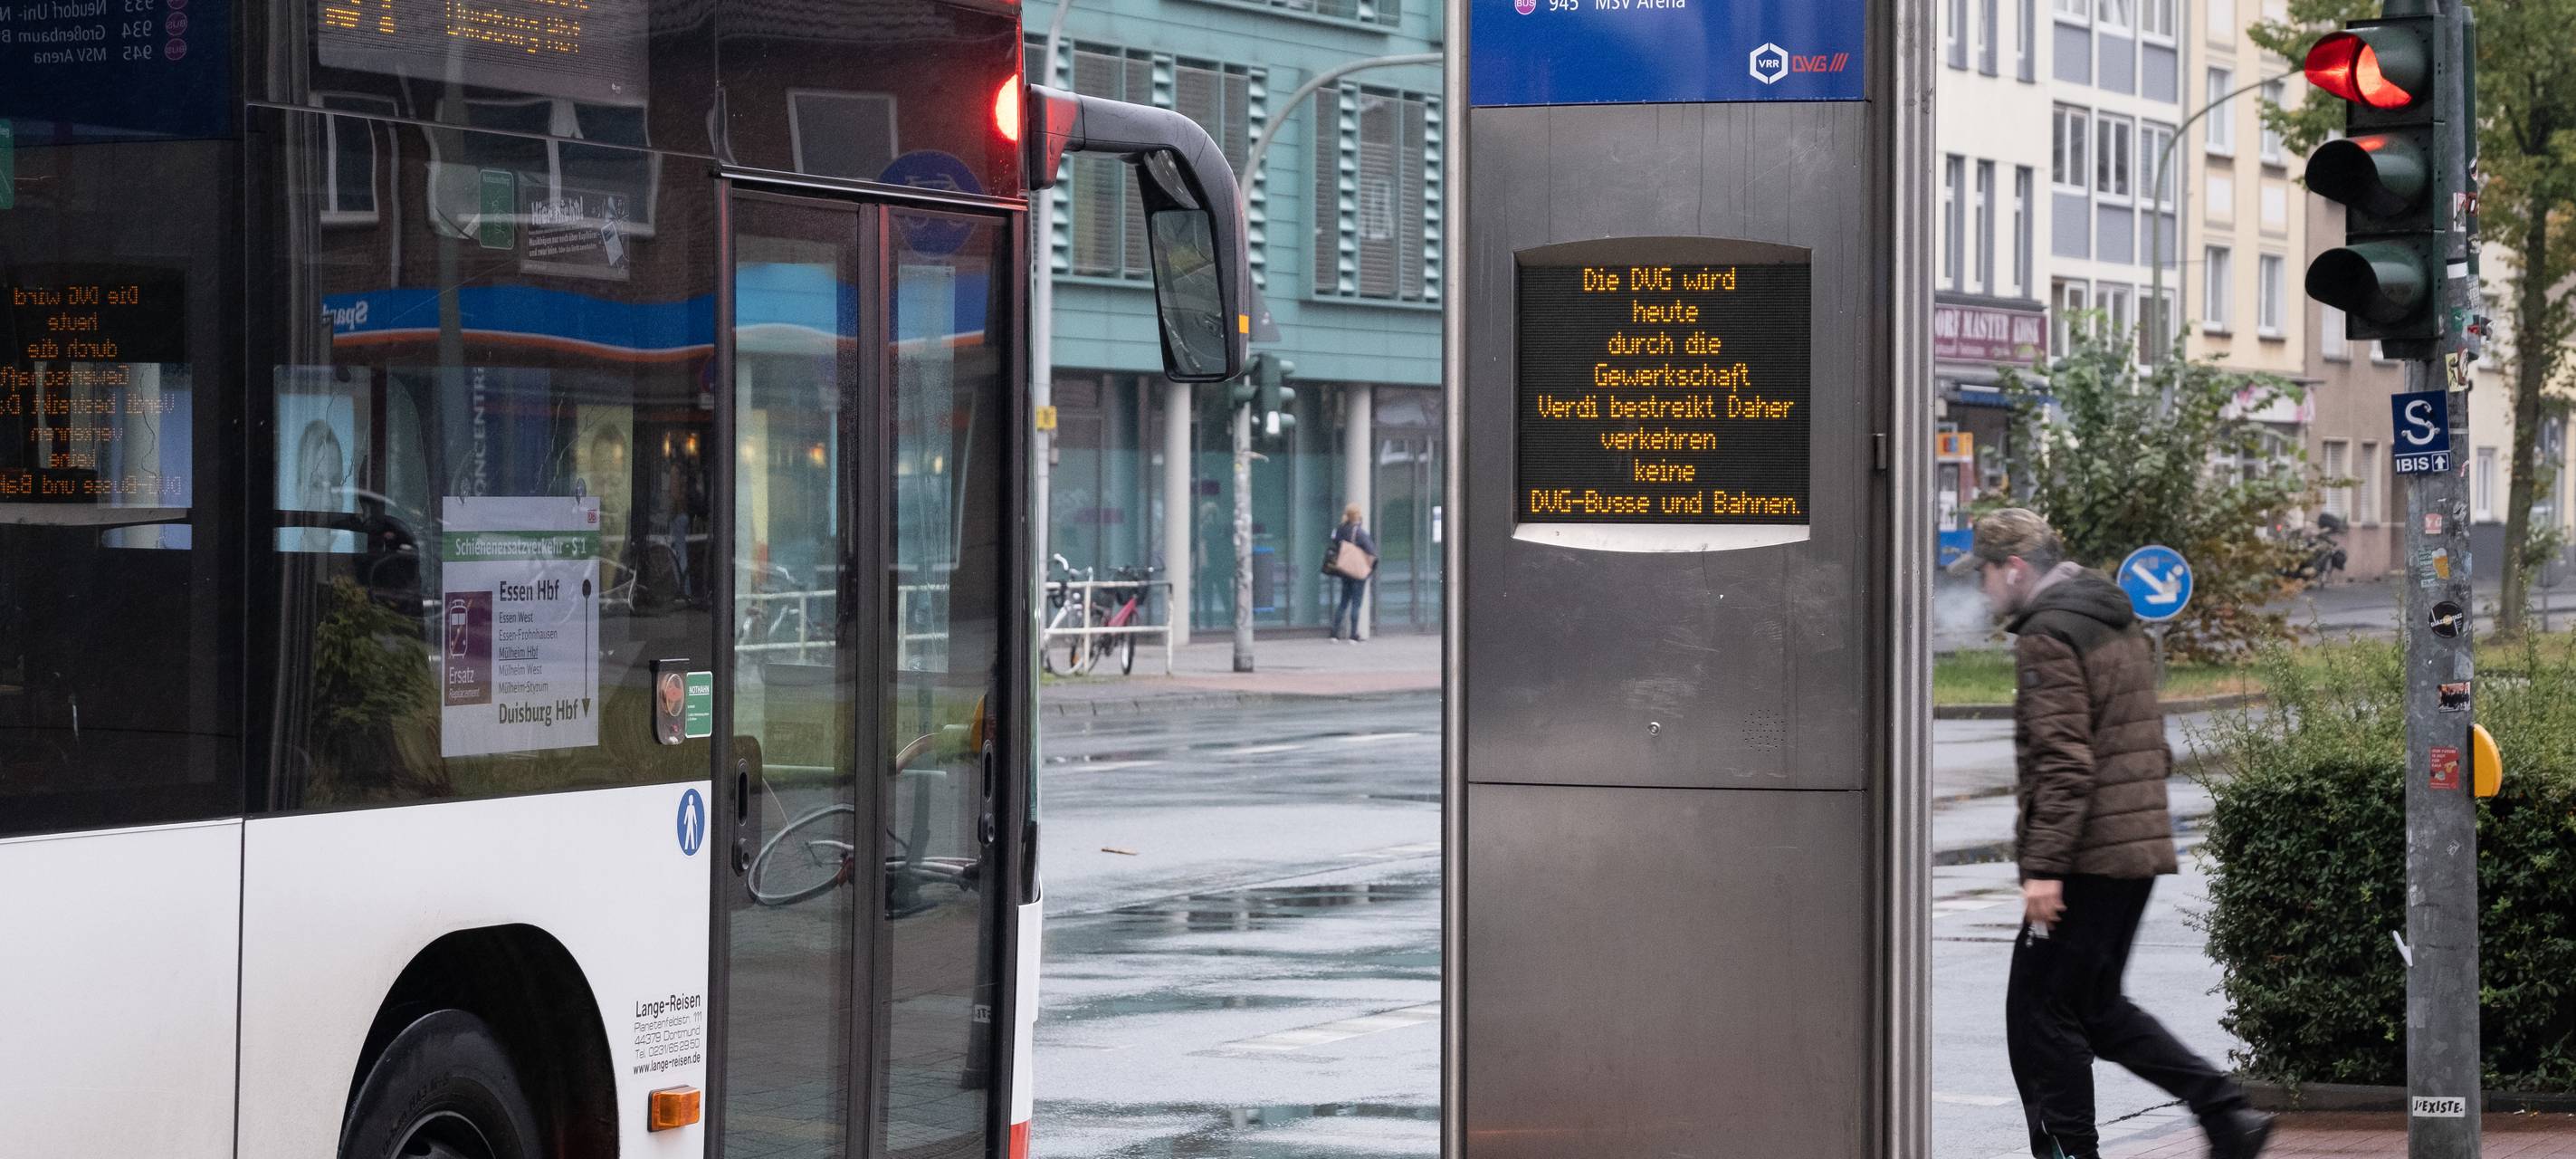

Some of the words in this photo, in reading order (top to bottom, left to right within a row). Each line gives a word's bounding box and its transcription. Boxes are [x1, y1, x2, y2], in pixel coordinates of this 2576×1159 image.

[1550, 0, 1579, 11] 945
[1596, 0, 1630, 10] MSV
[1636, 0, 1685, 8] Arena
[1758, 59, 1779, 69] VRR
[1792, 55, 1827, 72] DVG
[1584, 267, 1619, 291] Die
[1631, 267, 1672, 291] DVG
[1683, 267, 1736, 291] wird
[1633, 300, 1699, 322] heute
[1962, 311, 2008, 341] MASTER
[1608, 331, 1674, 355] durch
[1685, 331, 1722, 355] die
[1594, 363, 1751, 391] Gewerkschaft
[1539, 395, 1598, 417] Verdi
[1610, 395, 1716, 417] bestreikt
[1728, 395, 1794, 417] Daher
[1601, 426, 1716, 450] verkehren
[1635, 458, 1695, 482] keine
[2397, 456, 2429, 473] IBIS
[1531, 490, 1650, 513] DVG-Busse
[1662, 490, 1702, 513] und
[1714, 490, 1800, 514] Bahnen.
[455, 538, 563, 556] Schienenersatzverkehr
[500, 580, 533, 602] Essen
[538, 580, 559, 600] Hbf
[500, 612, 517, 624] Essen
[518, 611, 533, 623] West
[500, 629, 558, 642] Essen-Frohnhausen
[499, 648, 525, 659] Mülheim
[527, 647, 539, 658] Hbf
[449, 667, 474, 685] Ersatz
[499, 666, 525, 676] Mülheim
[527, 665, 542, 675] West
[499, 681, 549, 695] Mülheim-Styrum
[689, 685, 710, 694] NOTHAHN
[500, 703, 552, 726] Duisburg
[556, 699, 578, 721] Hbf
[635, 993, 701, 1019] Lange-Reisen
[634, 1031, 662, 1045] 44379
[663, 1026, 701, 1041] Dortmund
[633, 1051, 701, 1075] www.lange-reisen.de
[2414, 1100, 2463, 1114] J'EXISTE.
